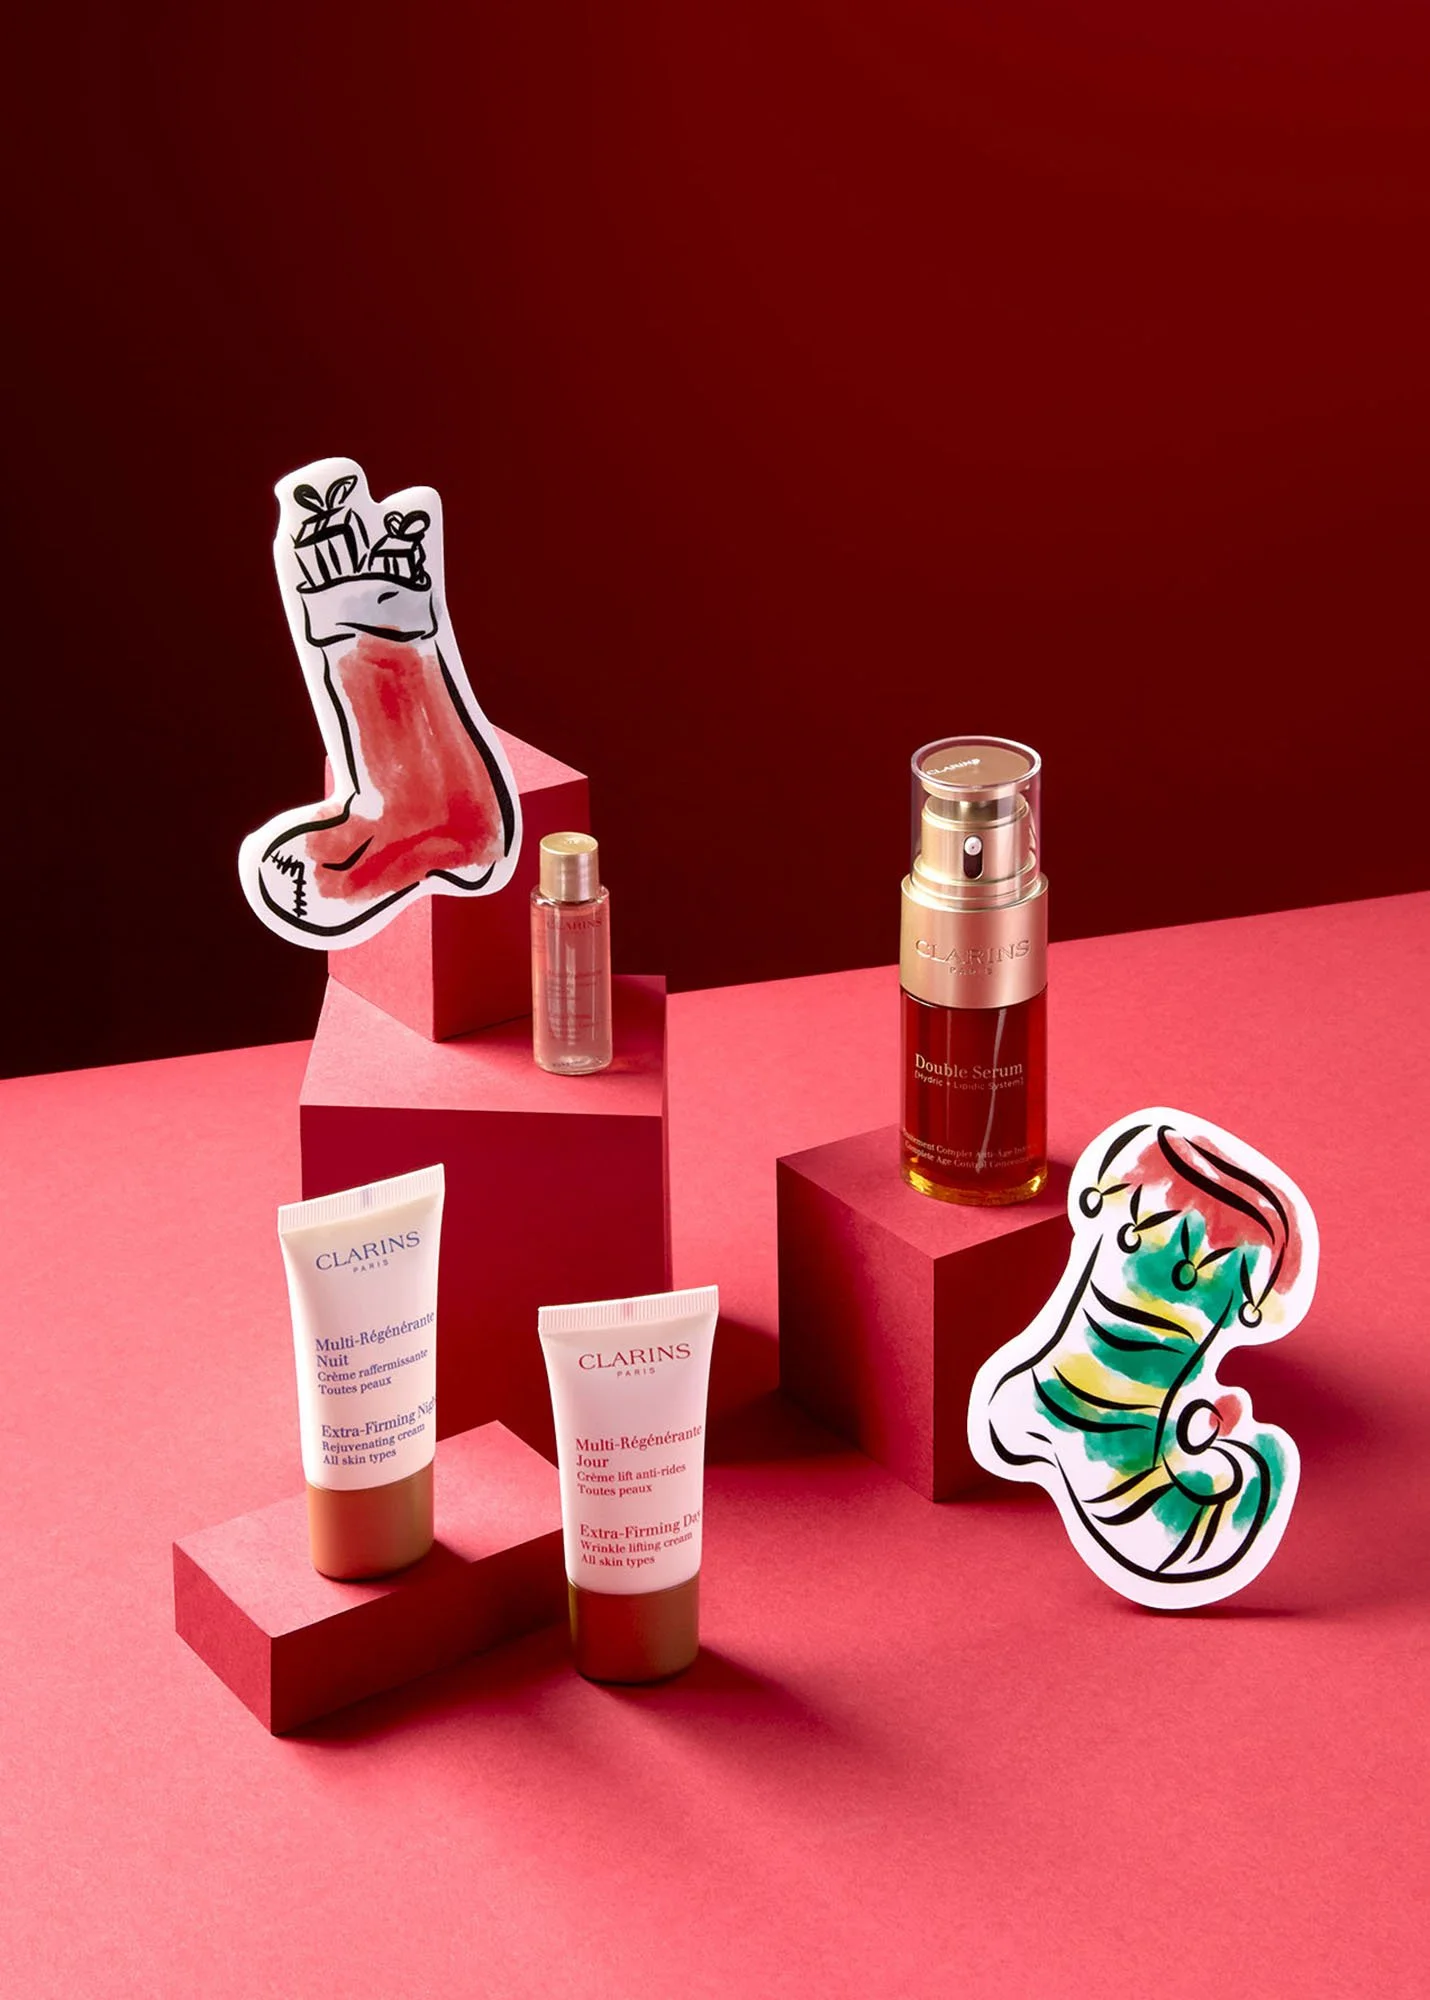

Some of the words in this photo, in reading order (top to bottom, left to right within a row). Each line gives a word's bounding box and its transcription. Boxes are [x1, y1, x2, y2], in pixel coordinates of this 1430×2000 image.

[915, 939, 1030, 964] CLARINS
[914, 1052, 968, 1078] Double
[972, 1063, 1023, 1079] Serum
[316, 1231, 420, 1272] CLARINS
[352, 1260, 390, 1273] PARIS
[316, 1311, 435, 1351] Multi-Régénérante
[316, 1354, 349, 1368] Nuit
[318, 1370, 356, 1382] Crème
[358, 1348, 428, 1378] raffermissante
[579, 1343, 692, 1370] CLARINS
[617, 1368, 656, 1377] PARIS
[318, 1383, 357, 1395] Toutes
[360, 1376, 392, 1394] peaux
[322, 1411, 415, 1438] Extra-Firming
[322, 1434, 395, 1453] Rejuvenating
[398, 1422, 425, 1441] cream
[576, 1424, 702, 1452] Multi-Régénérante
[322, 1452, 338, 1465] All
[342, 1450, 366, 1464] skin
[368, 1448, 396, 1464] types
[576, 1454, 609, 1468] Jour
[577, 1471, 616, 1483] Crème
[618, 1468, 634, 1481] lift
[636, 1462, 686, 1480] anti-rides
[578, 1484, 616, 1496] Toutes
[619, 1484, 653, 1497] peaux
[580, 1520, 680, 1540] Extra-Firming
[580, 1540, 625, 1554] Wrinkle
[629, 1537, 661, 1553] lifting
[664, 1531, 693, 1547] cream
[581, 1554, 596, 1565] All
[600, 1554, 624, 1566] skin
[626, 1555, 655, 1568] types
